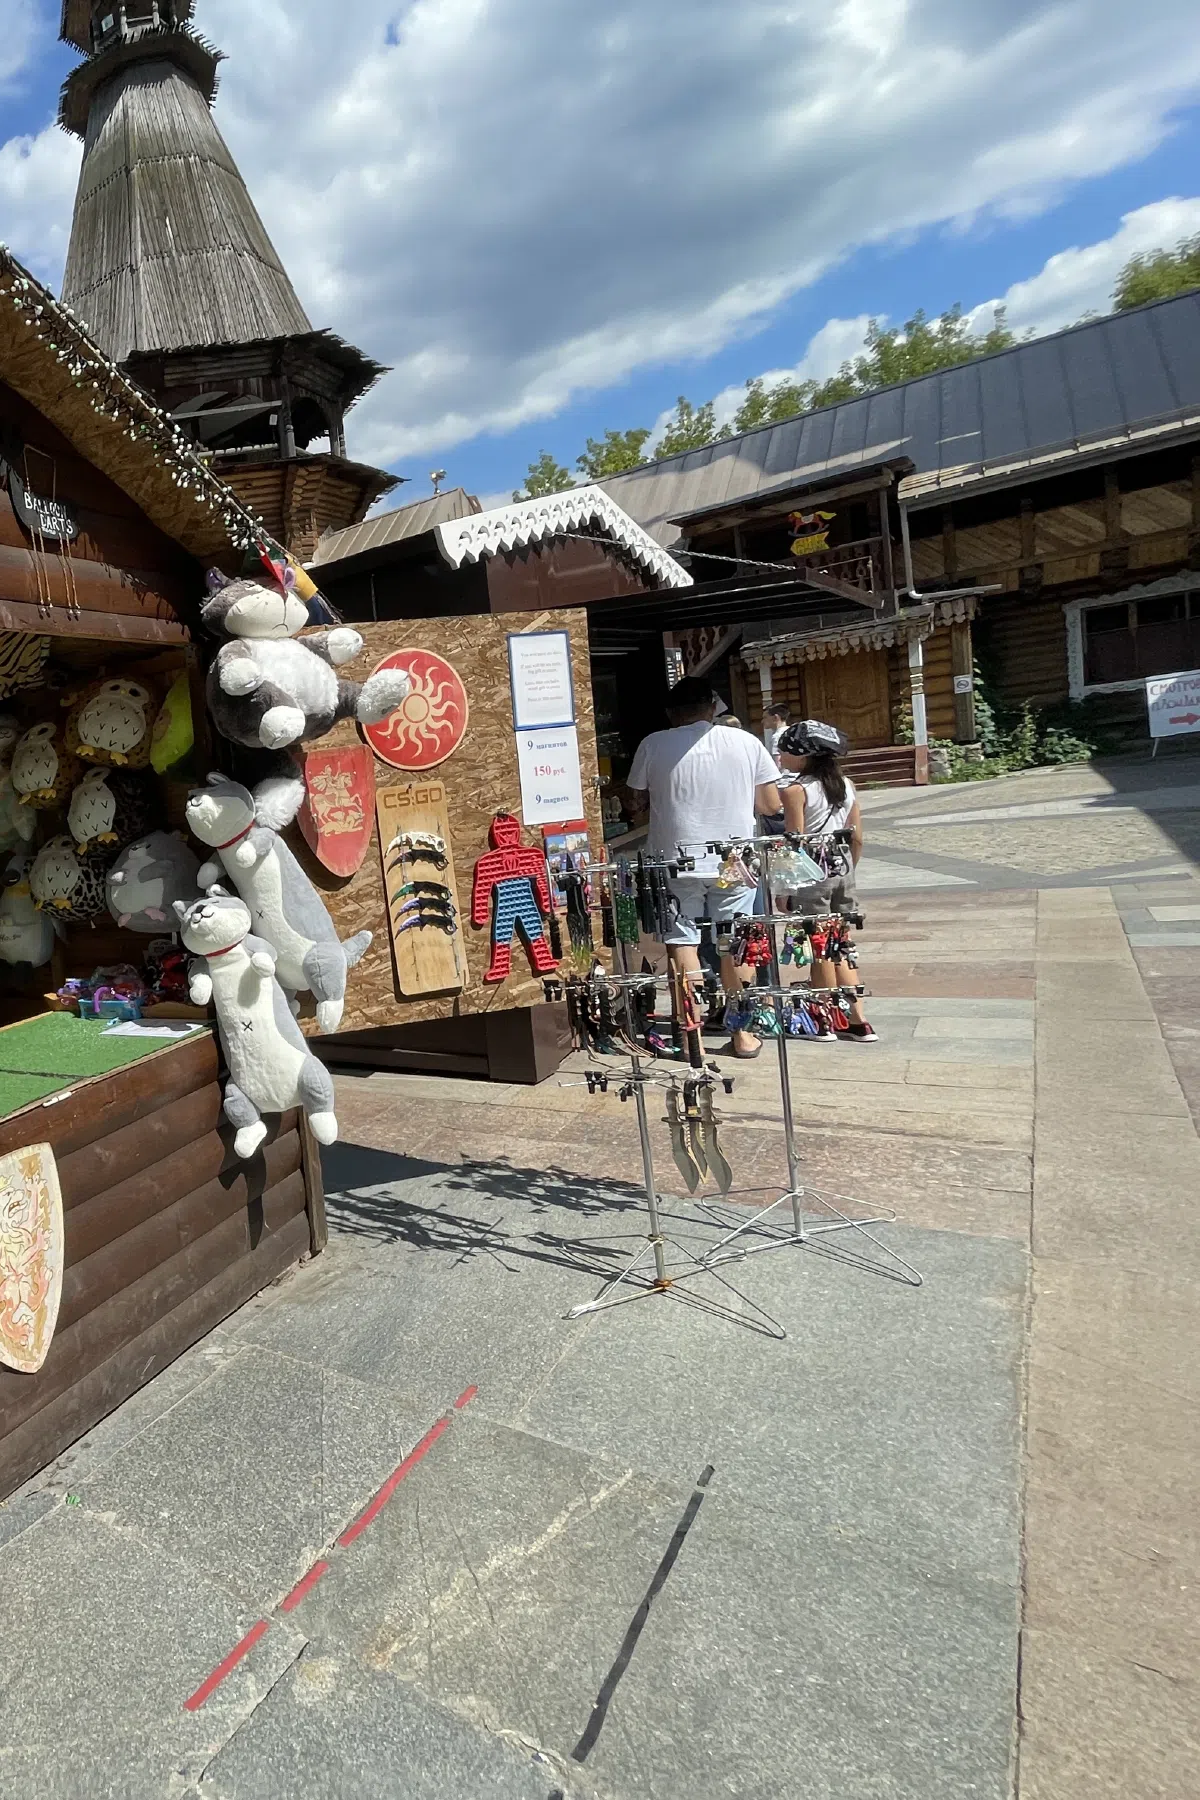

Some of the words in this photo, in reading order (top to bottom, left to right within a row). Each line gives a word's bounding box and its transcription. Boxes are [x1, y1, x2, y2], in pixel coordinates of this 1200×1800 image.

[23, 491, 67, 519] BALLOON
[40, 513, 74, 535] DARTS
[527, 740, 534, 751] 9
[536, 741, 568, 750] магнитов
[534, 765, 552, 777] 150
[383, 787, 443, 809] CS:GO
[535, 794, 542, 805] 9
[543, 796, 570, 804] magnets
